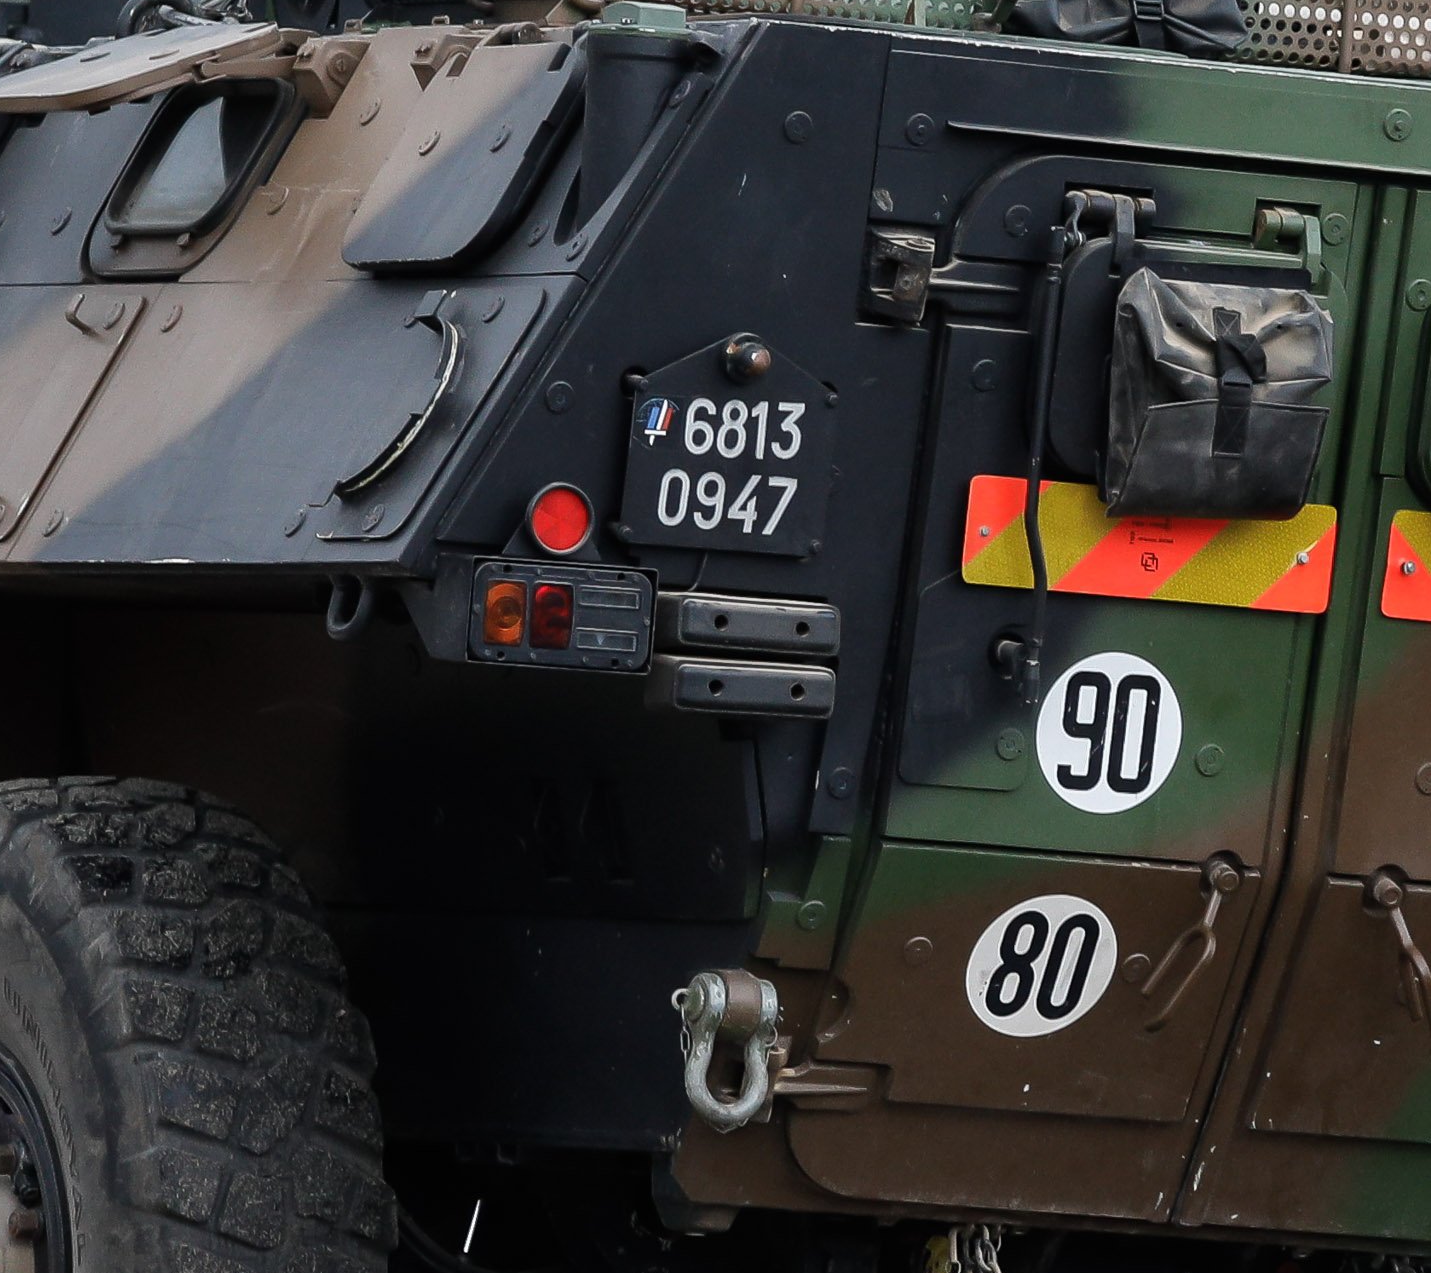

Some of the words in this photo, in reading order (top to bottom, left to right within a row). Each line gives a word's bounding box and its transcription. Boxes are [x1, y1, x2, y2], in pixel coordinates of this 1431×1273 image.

[683, 397, 806, 460] 6813
[657, 468, 798, 536] 0947
[1056, 670, 1161, 794] 90
[984, 909, 1101, 1021] 80
